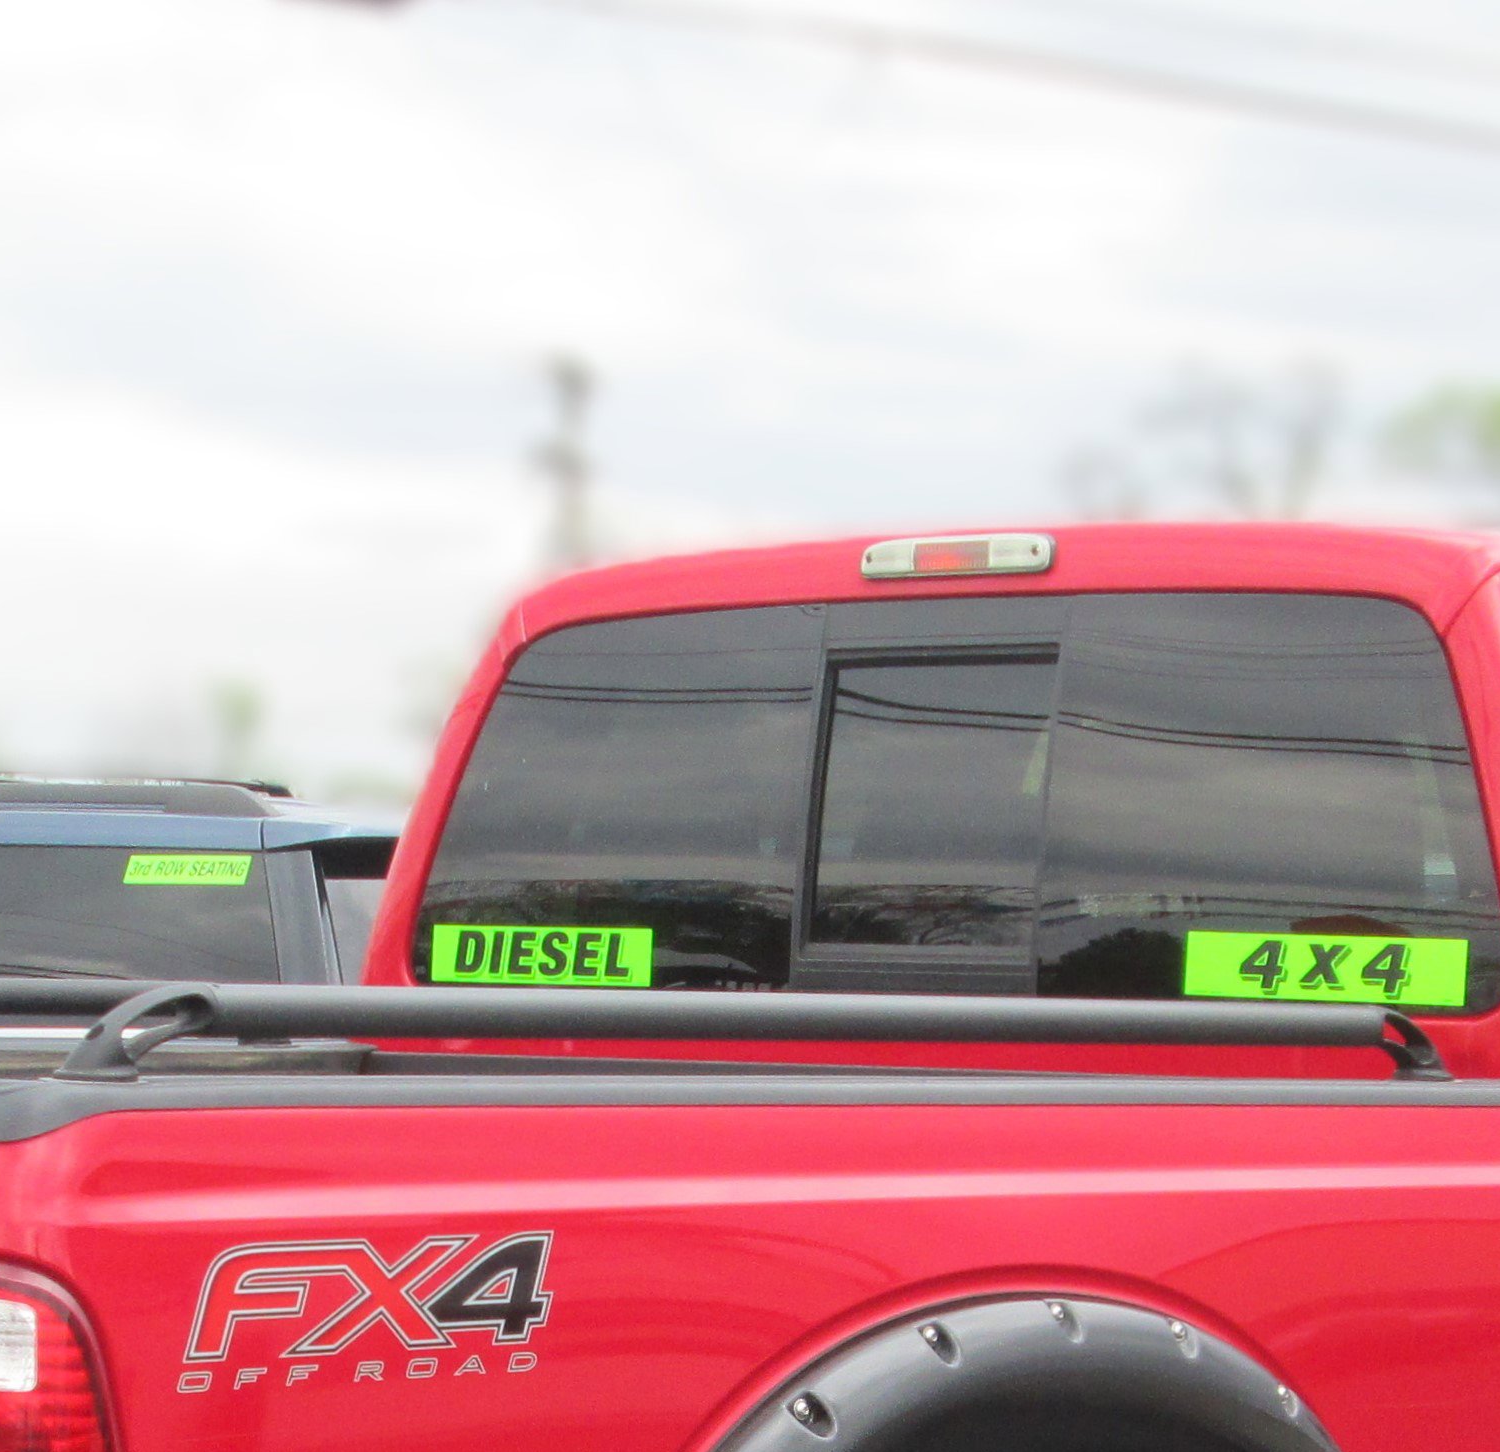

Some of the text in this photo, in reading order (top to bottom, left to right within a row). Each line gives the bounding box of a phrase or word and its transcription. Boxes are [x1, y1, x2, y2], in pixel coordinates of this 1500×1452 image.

[129, 861, 247, 877] 3rd ROW SEATING
[454, 930, 632, 981] DIESEL
[182, 1230, 554, 1364] FX4
[176, 1352, 538, 1393] OFF ROAD
